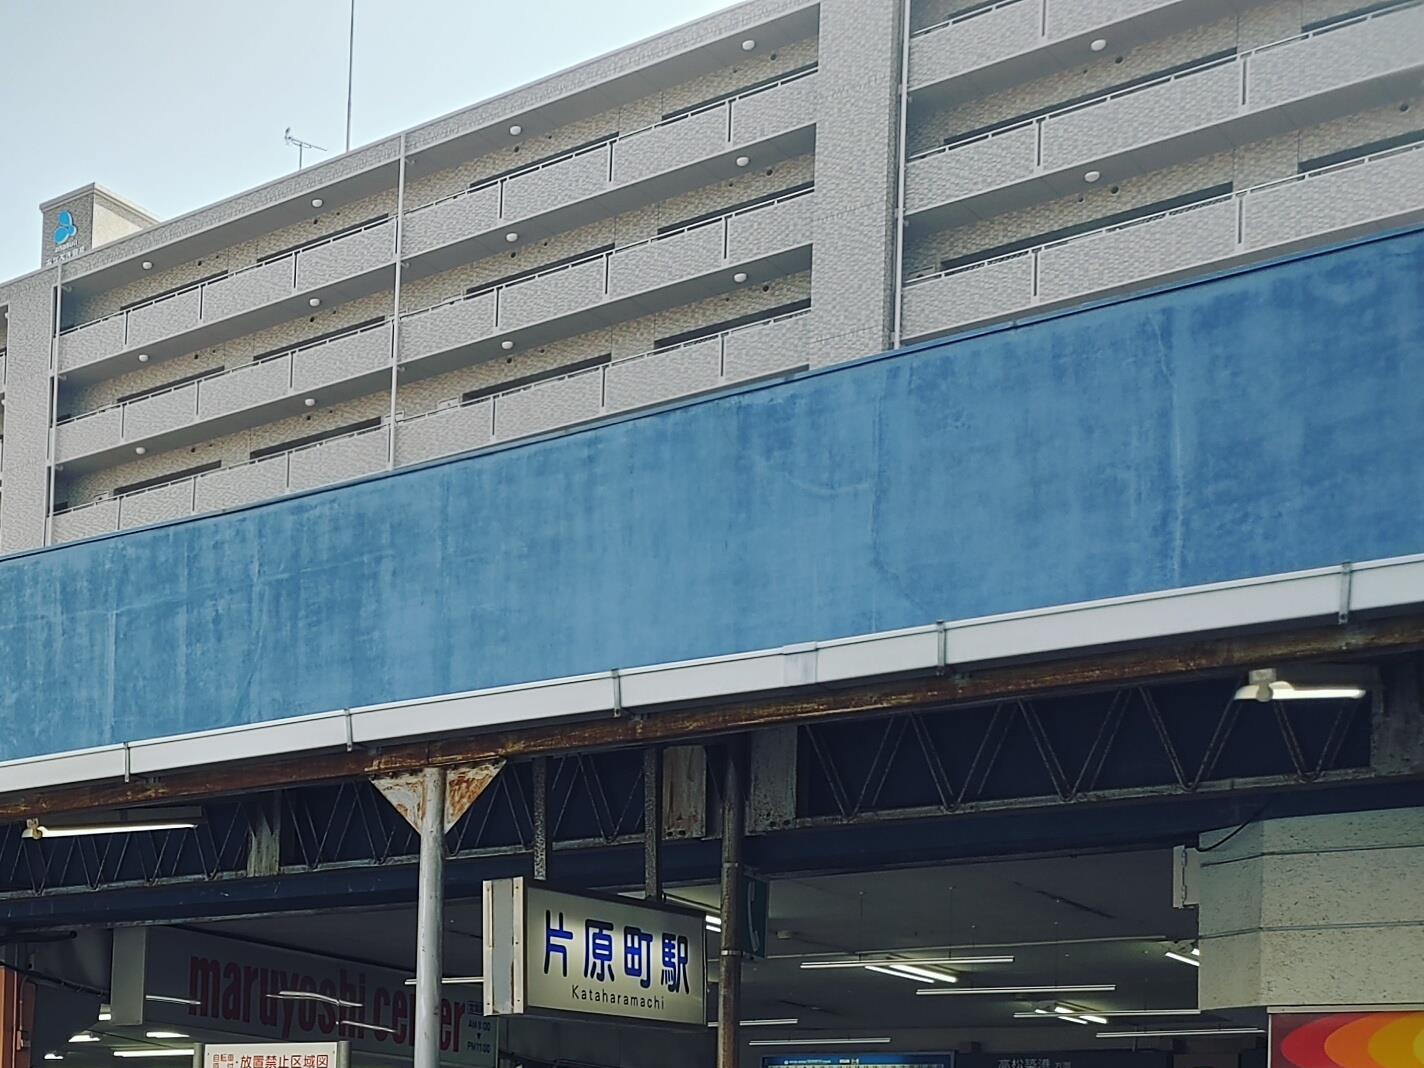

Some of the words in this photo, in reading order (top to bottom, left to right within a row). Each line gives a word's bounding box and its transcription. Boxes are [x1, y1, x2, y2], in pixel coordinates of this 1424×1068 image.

[543, 909, 690, 995] 片原町駅
[188, 956, 367, 1040] maruyoshi
[375, 983, 466, 1053] ceer
[572, 984, 665, 1010] Kataharamachi
